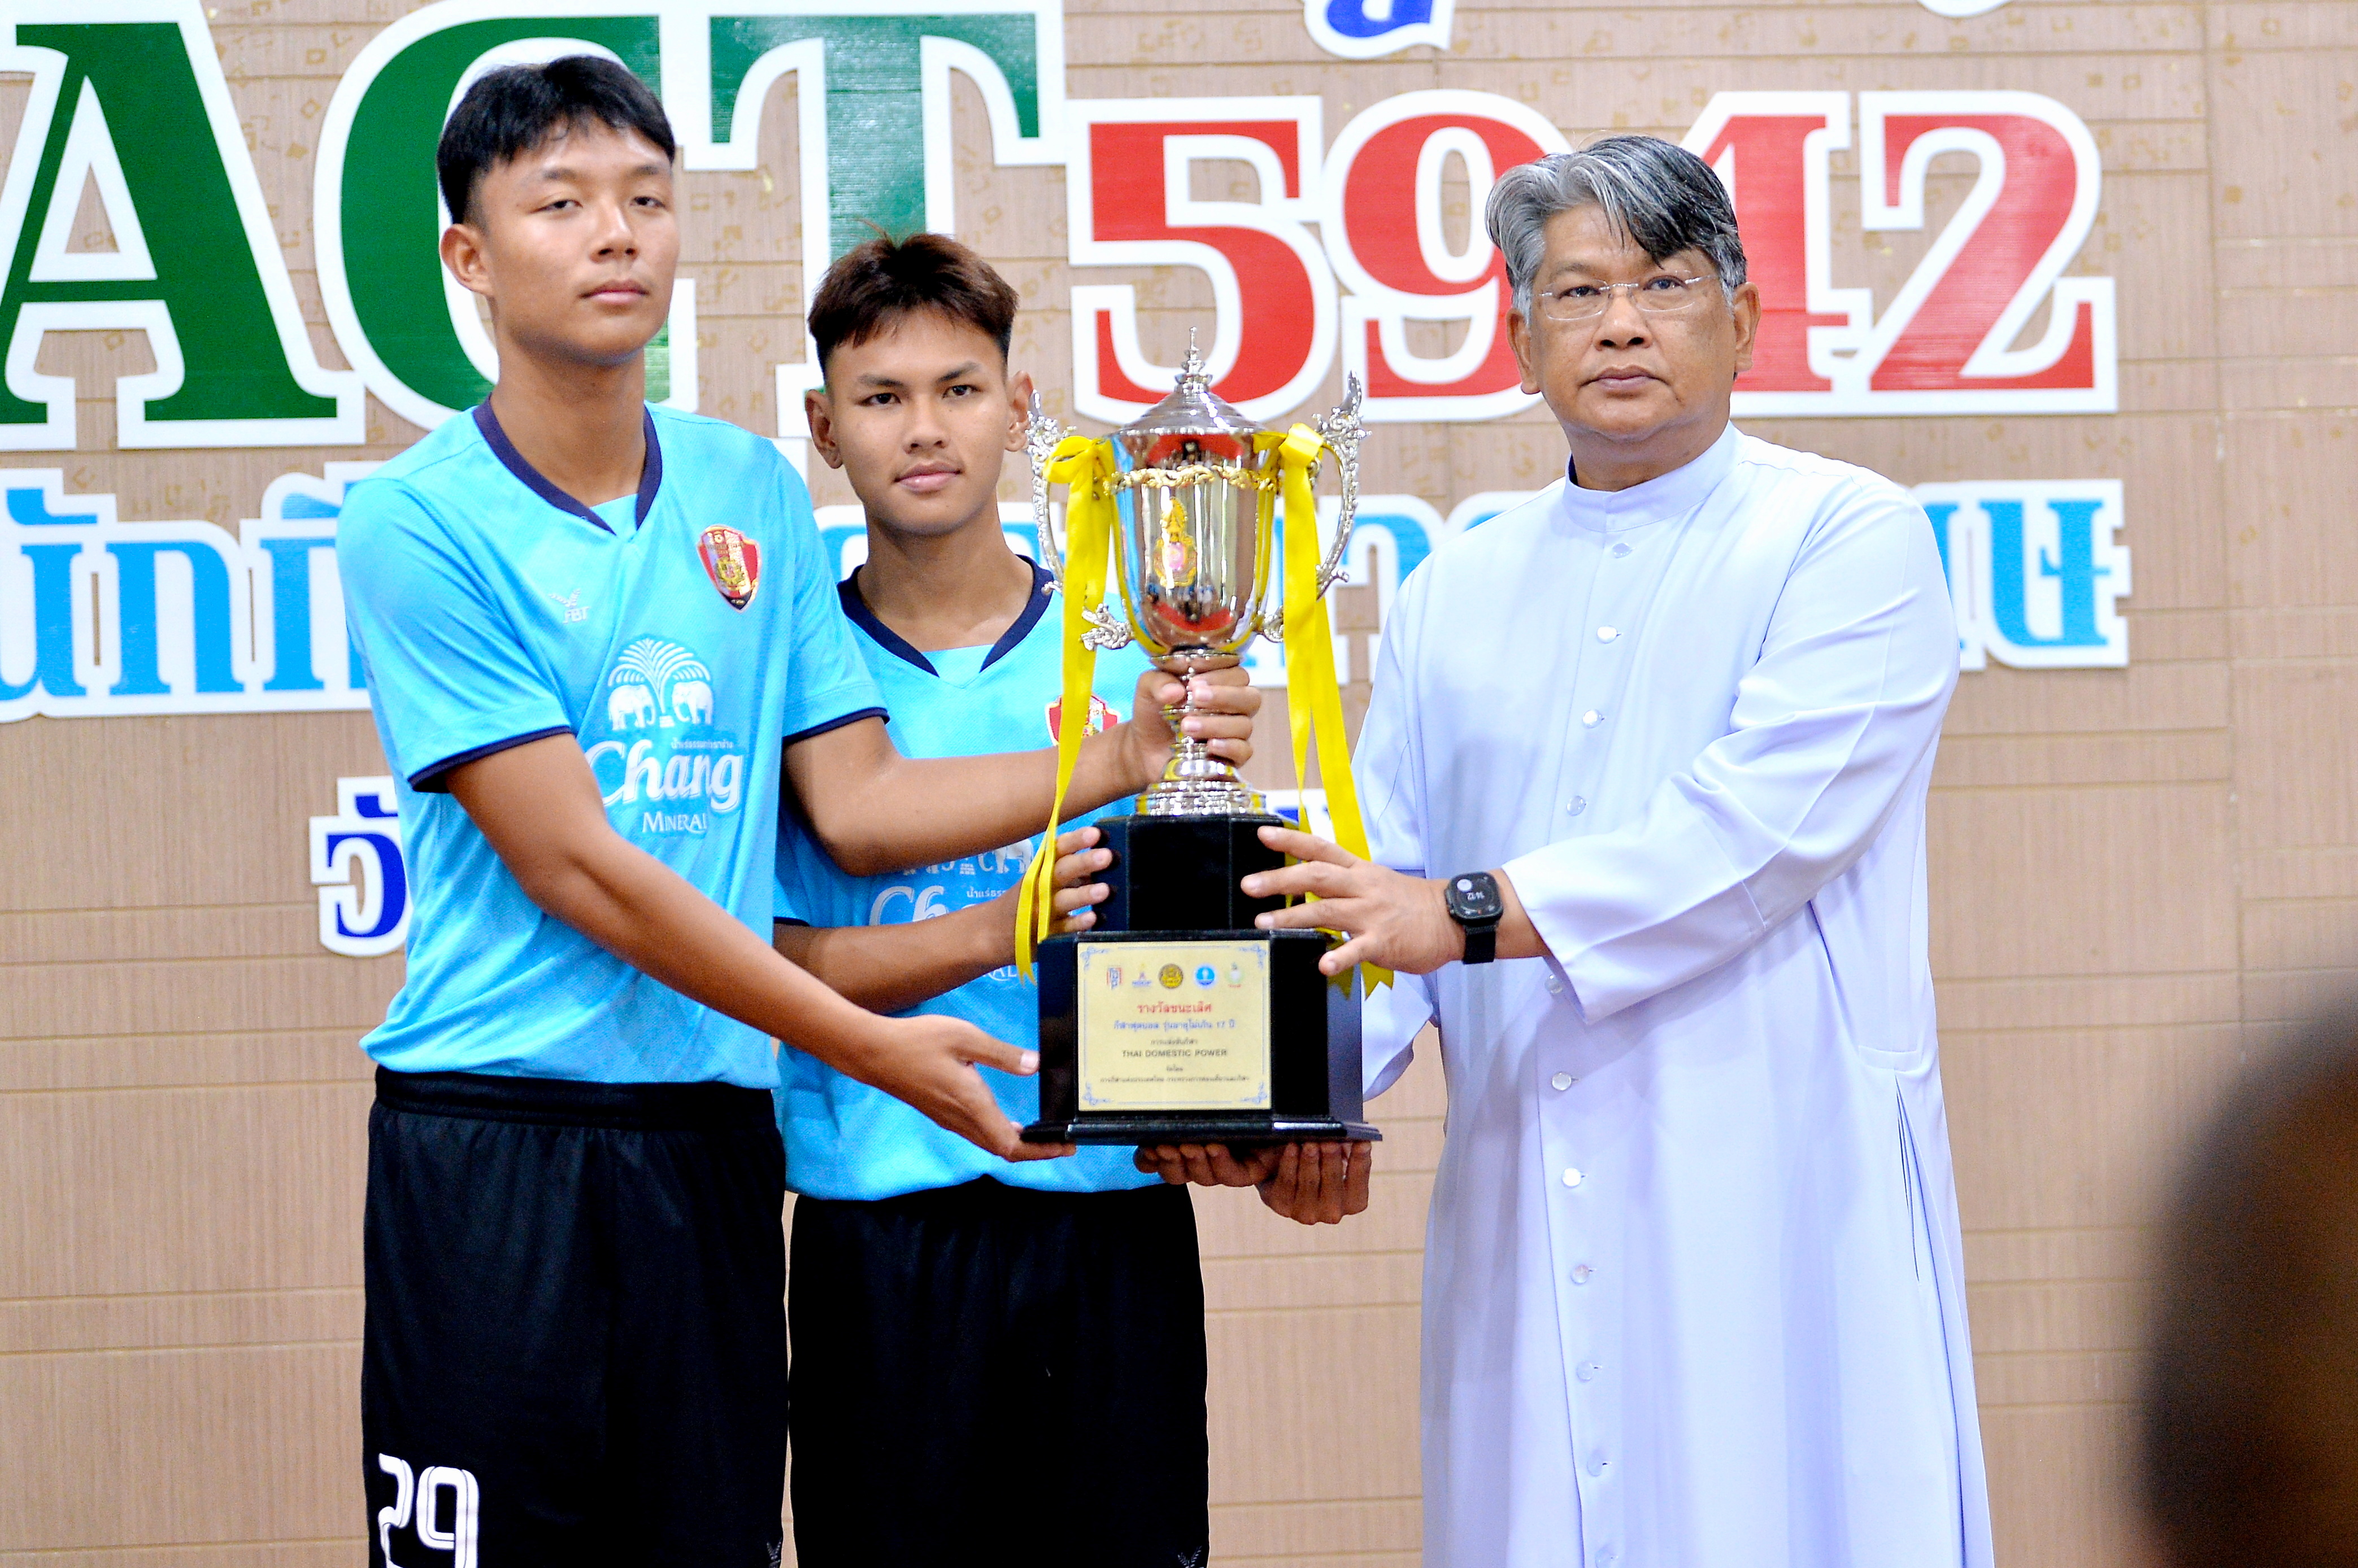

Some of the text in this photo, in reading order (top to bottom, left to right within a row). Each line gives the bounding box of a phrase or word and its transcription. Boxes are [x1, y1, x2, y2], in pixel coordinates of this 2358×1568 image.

[1089, 113, 2094, 406] 5942
[562, 606, 591, 624] FBT
[584, 739, 743, 812] Chang
[1137, 1001, 1212, 1014] รางวัลชนะเลิศ
[1145, 1049, 1191, 1057] DOMESTIC
[378, 1453, 479, 1568] 29
